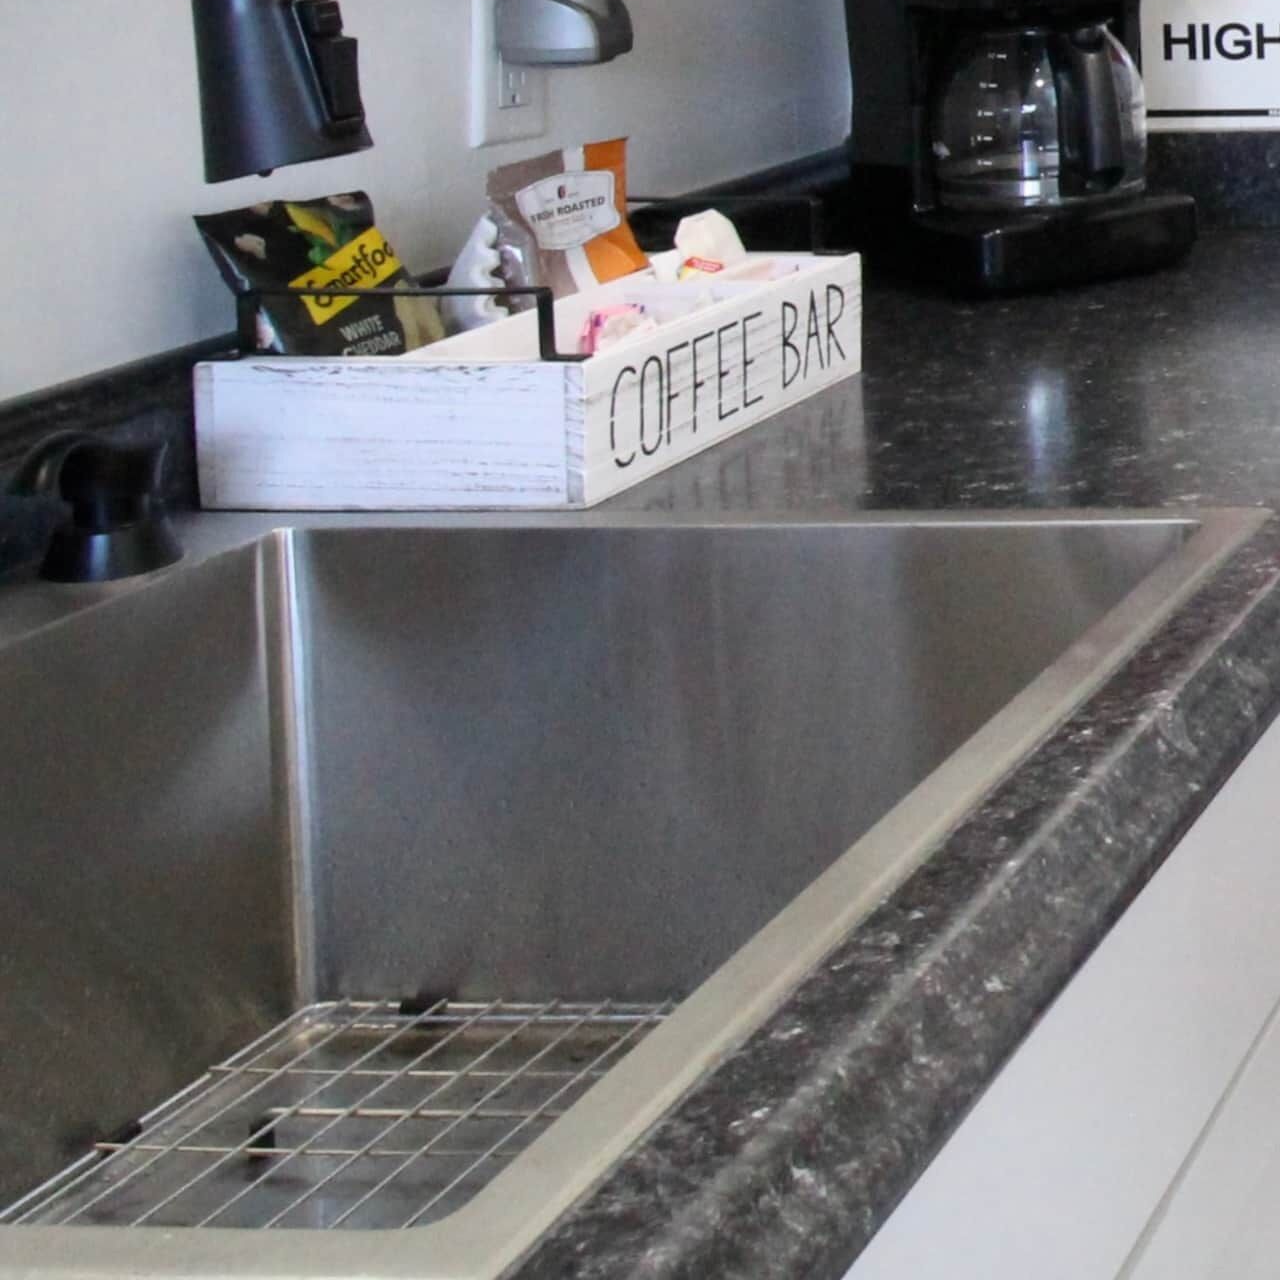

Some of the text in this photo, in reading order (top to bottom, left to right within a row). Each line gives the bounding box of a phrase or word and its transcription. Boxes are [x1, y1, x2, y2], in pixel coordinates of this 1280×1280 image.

[557, 196, 605, 216] ROASTED
[340, 314, 384, 341] WHITE
[611, 283, 846, 468] COFFEE BAR
